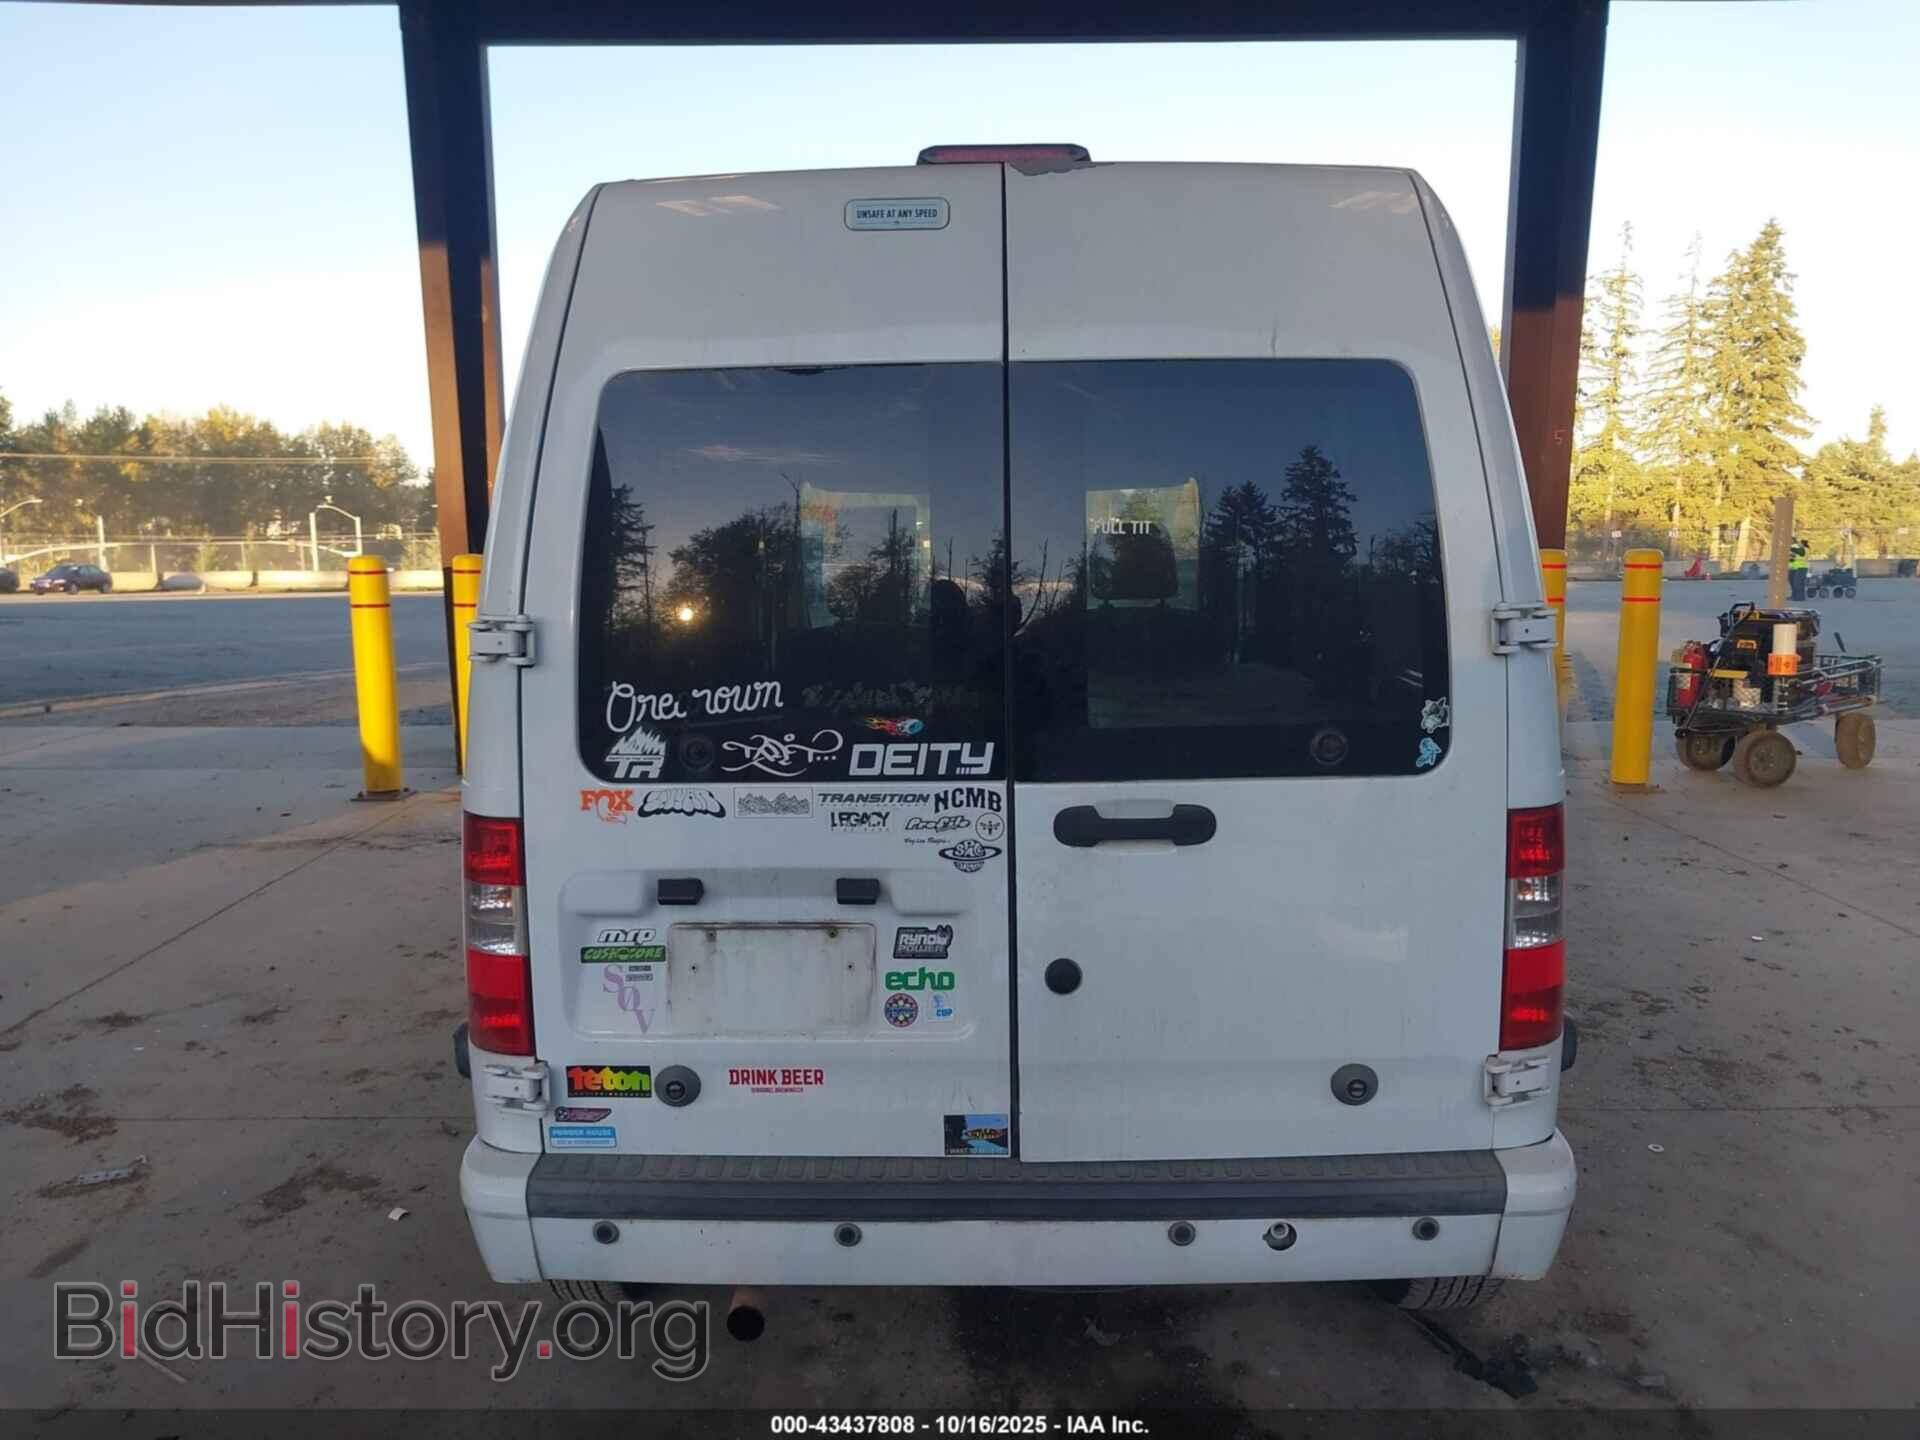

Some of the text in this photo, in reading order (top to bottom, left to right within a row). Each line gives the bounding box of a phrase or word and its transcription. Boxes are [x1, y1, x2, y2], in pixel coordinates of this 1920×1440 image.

[856, 208, 938, 219] UNSAFE AT ANY SPEED
[849, 742, 995, 776] DEITY
[579, 789, 635, 812] FOX
[818, 793, 930, 803] TRANSITION
[934, 787, 1002, 814] NCMB
[885, 967, 955, 990] echo
[728, 1069, 824, 1086] DRINK BEER
